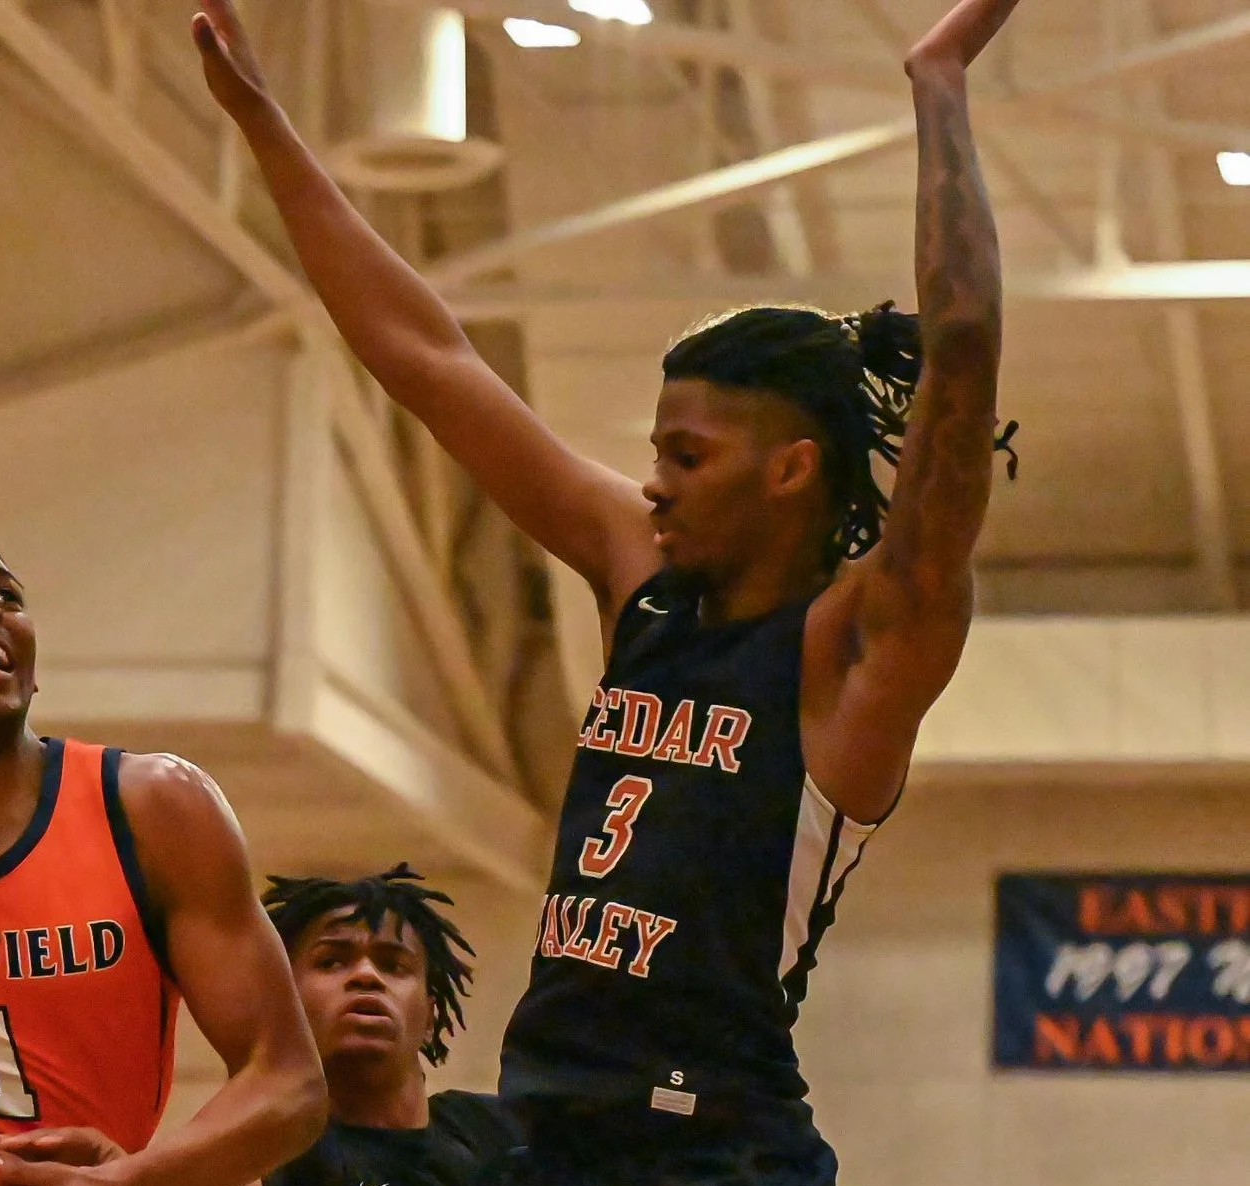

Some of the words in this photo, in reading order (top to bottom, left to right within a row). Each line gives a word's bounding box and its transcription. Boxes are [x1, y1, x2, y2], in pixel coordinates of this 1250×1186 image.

[579, 774, 652, 878] 3
[535, 894, 678, 978] ALLEY
[670, 1070, 684, 1086] S
